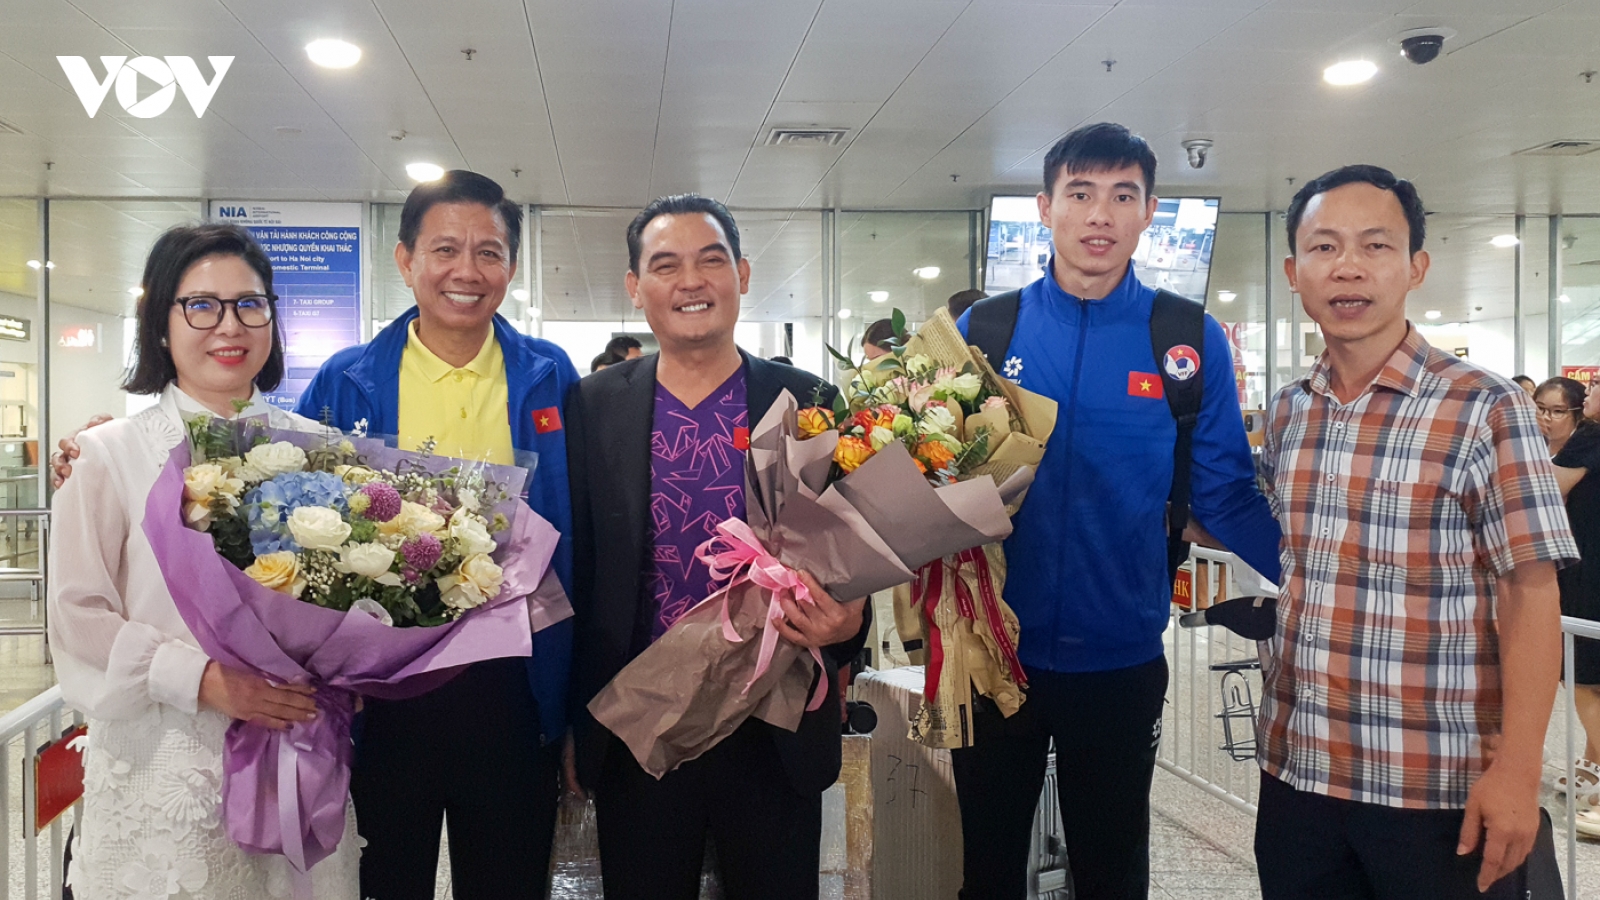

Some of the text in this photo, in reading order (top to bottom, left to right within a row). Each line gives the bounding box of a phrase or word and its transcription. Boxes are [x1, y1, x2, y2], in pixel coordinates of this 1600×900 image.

[220, 206, 247, 217] NIA
[299, 229, 320, 240] KHÁCH
[312, 255, 325, 263] city
